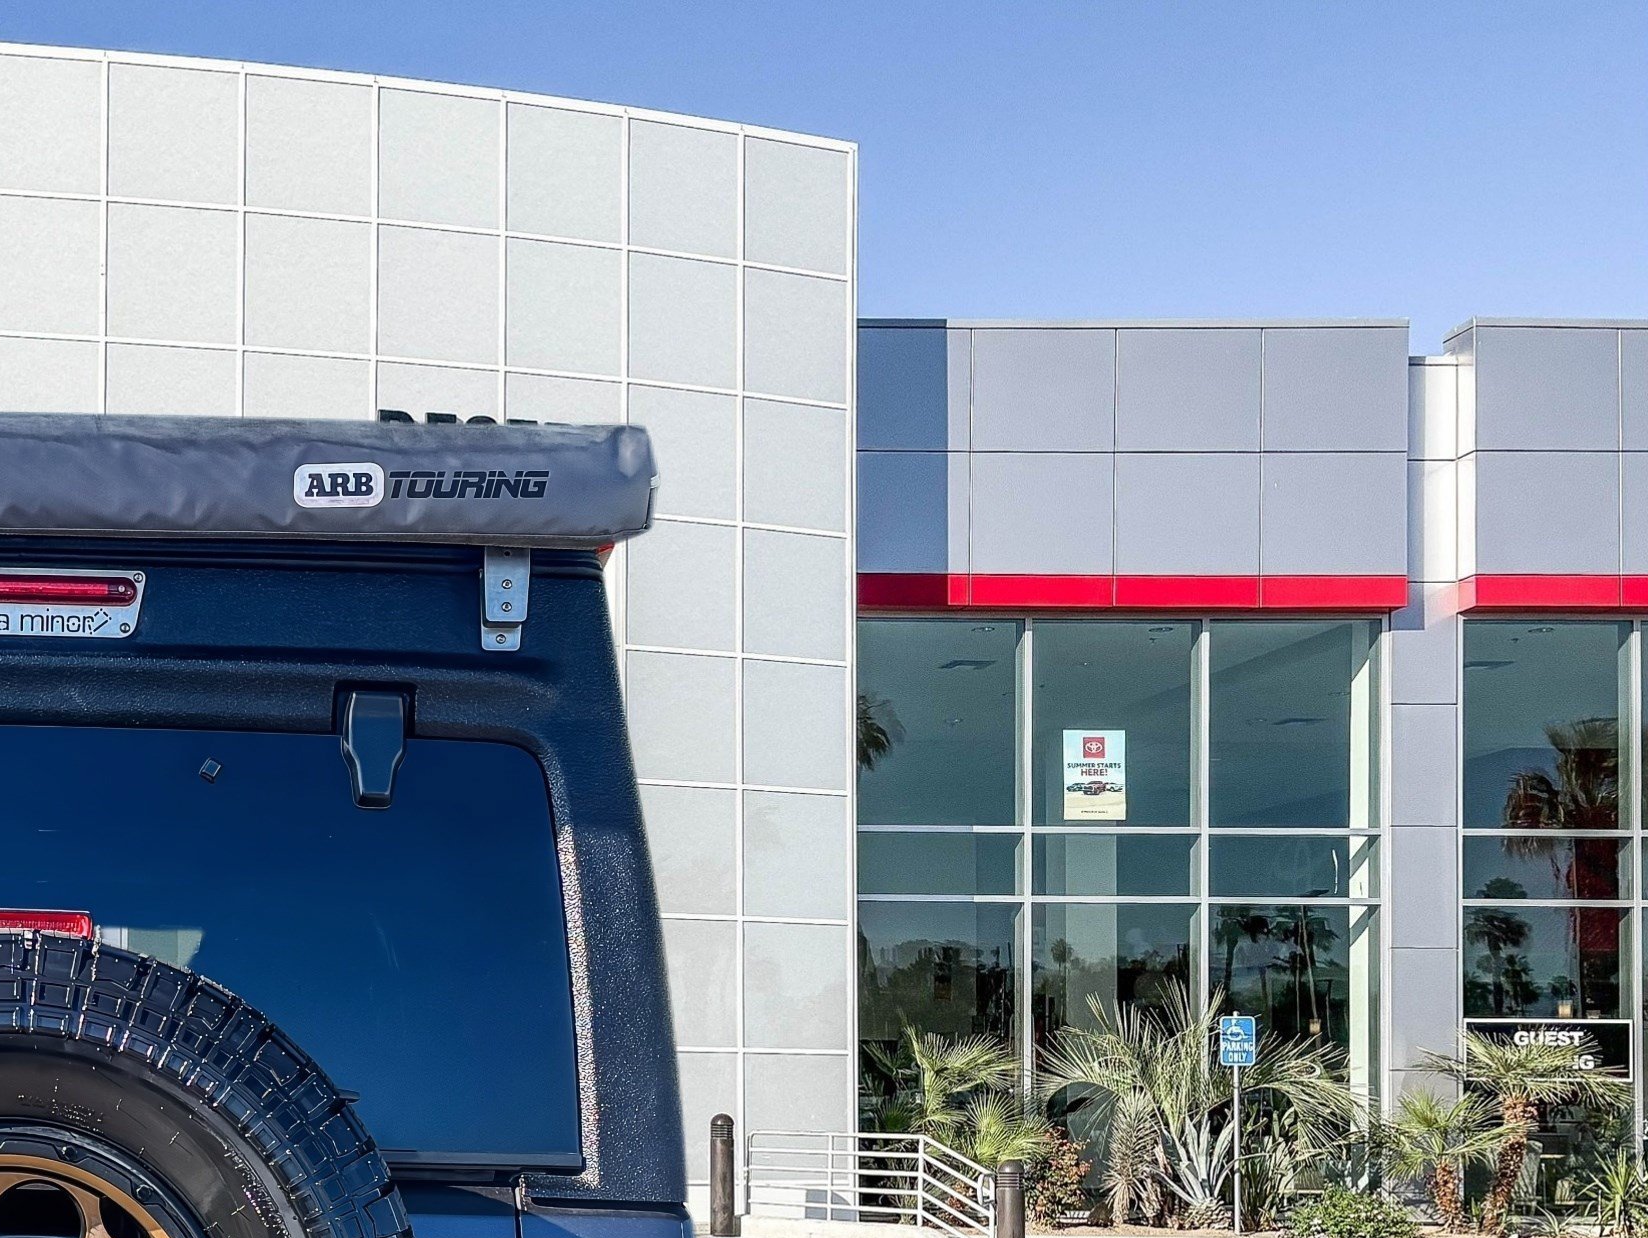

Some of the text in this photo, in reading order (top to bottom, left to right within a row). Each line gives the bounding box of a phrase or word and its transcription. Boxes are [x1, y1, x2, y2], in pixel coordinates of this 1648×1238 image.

[304, 470, 550, 499] ARB TOURING
[19, 607, 95, 634] minor
[1080, 768, 1108, 776] HERE!
[1513, 1030, 1584, 1047] GUEST
[1222, 1041, 1254, 1051] PARKING
[1228, 1051, 1247, 1062] ONLY
